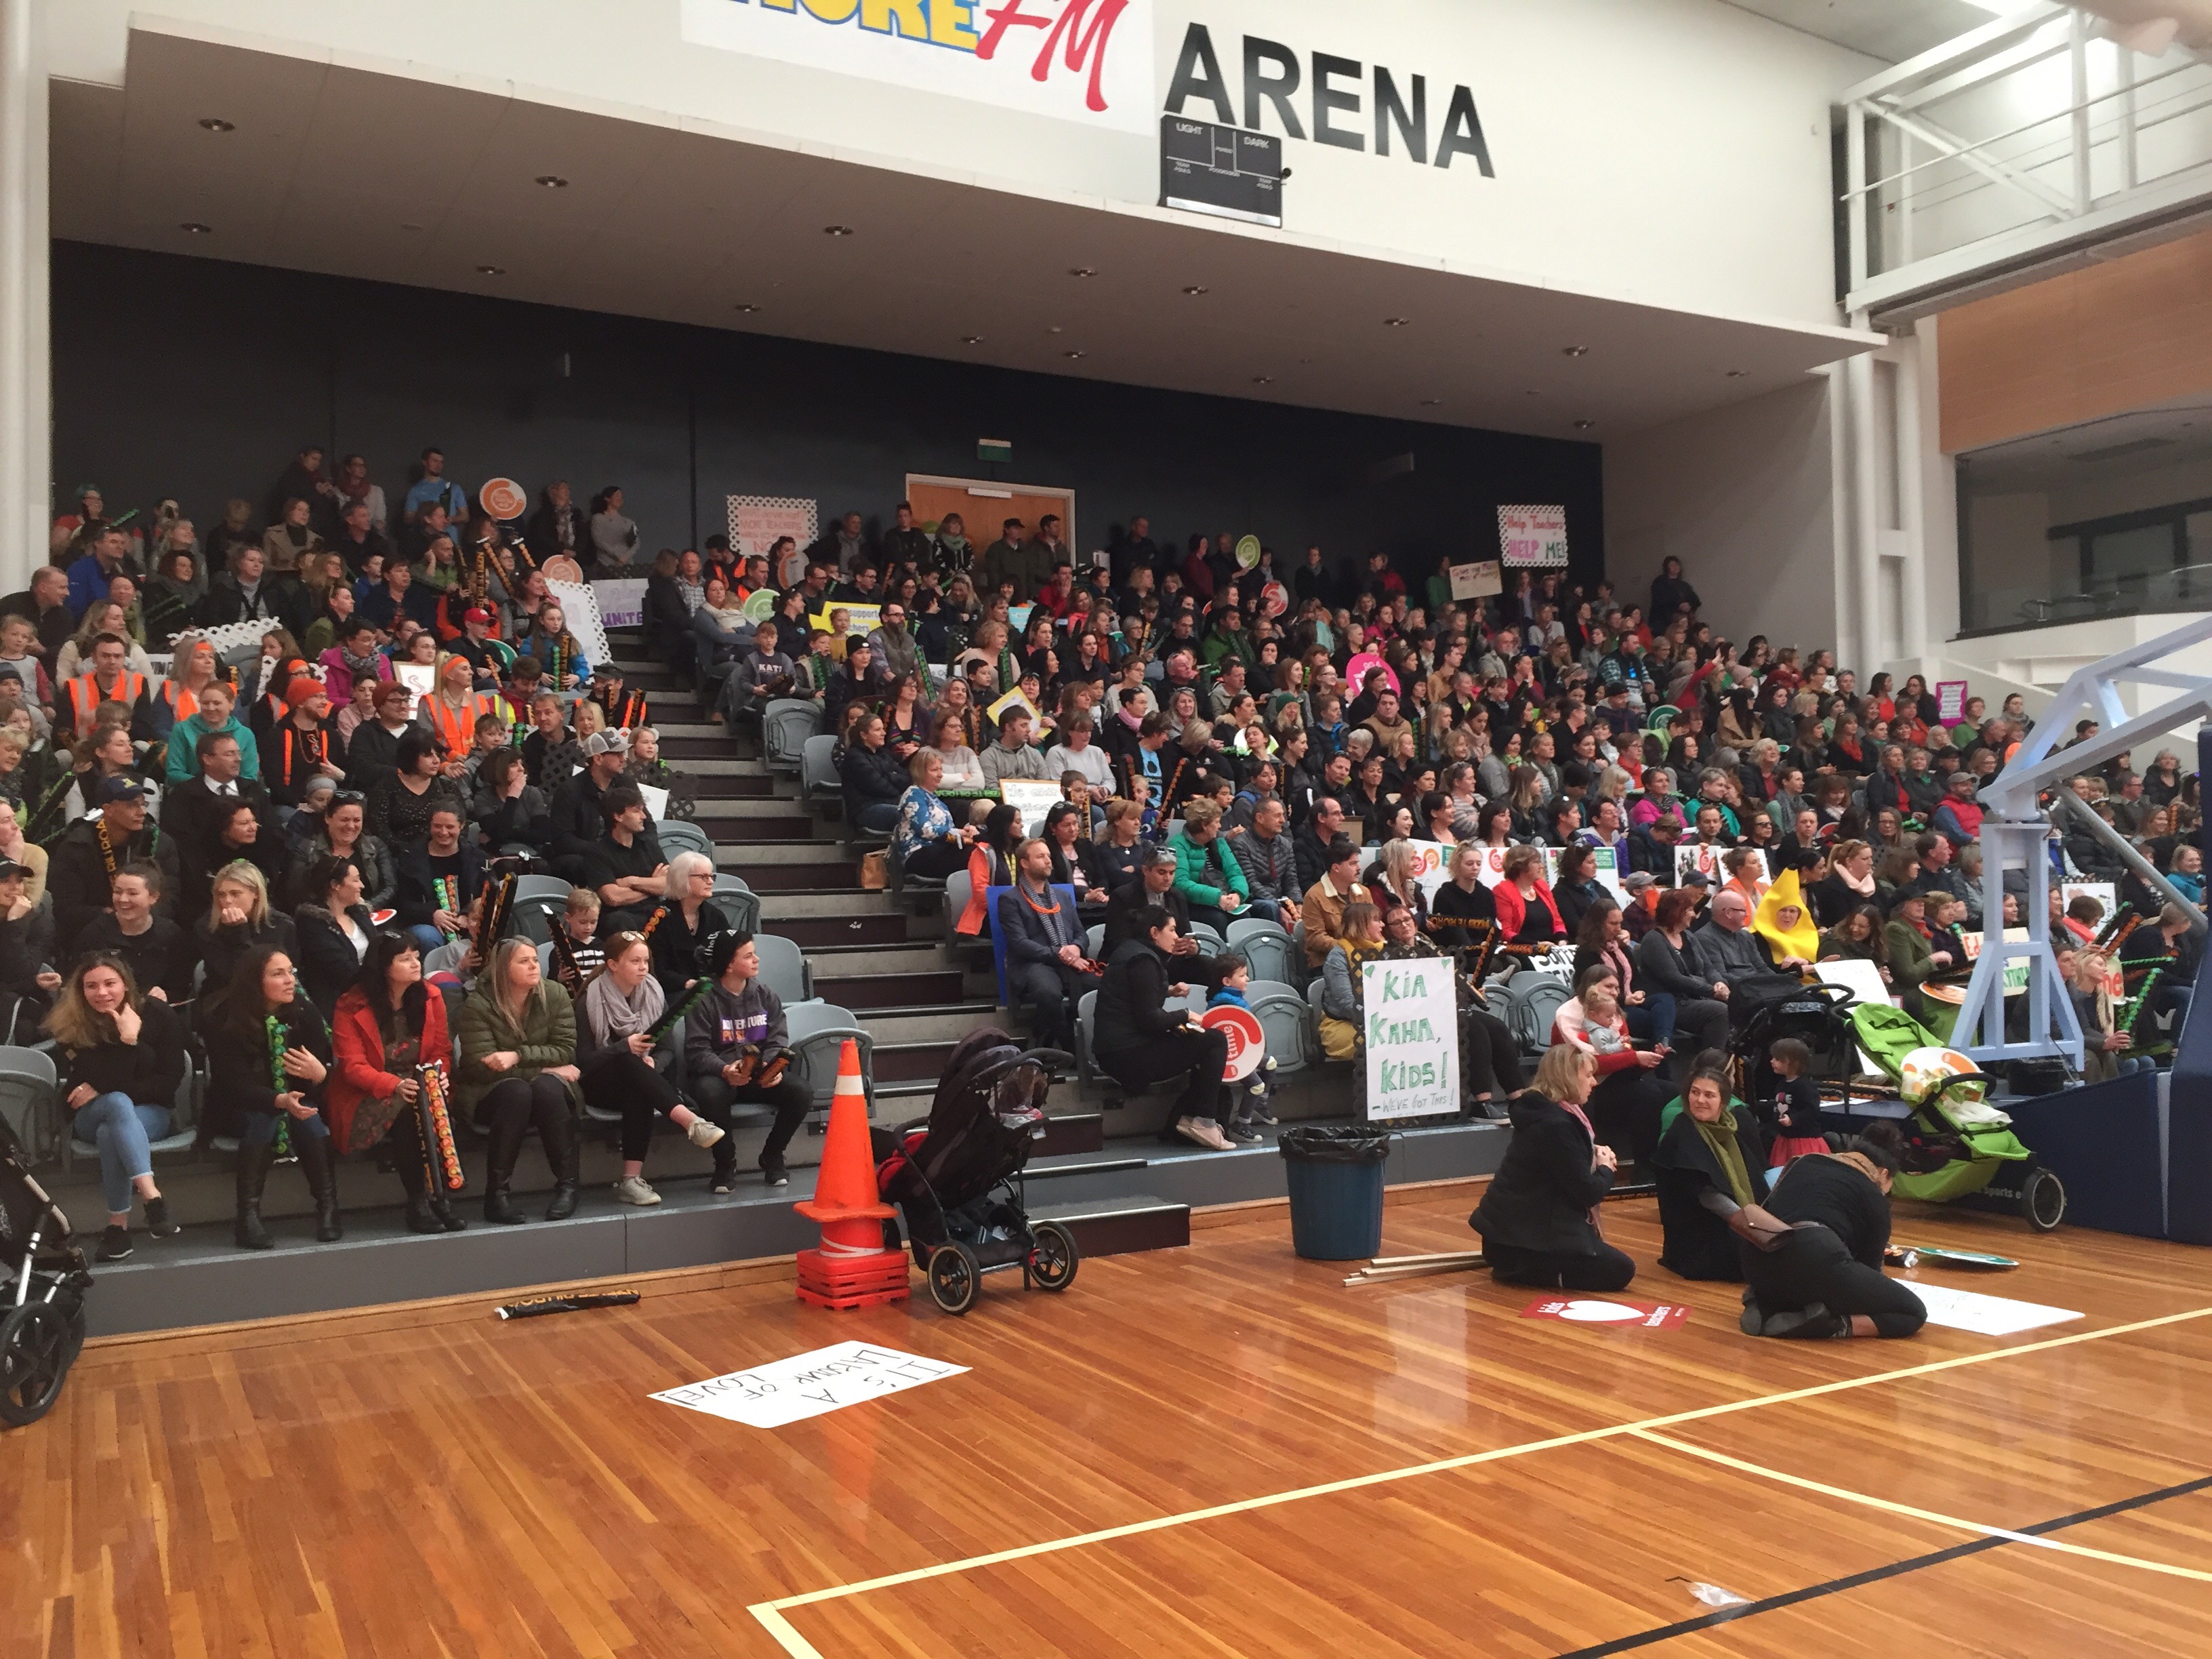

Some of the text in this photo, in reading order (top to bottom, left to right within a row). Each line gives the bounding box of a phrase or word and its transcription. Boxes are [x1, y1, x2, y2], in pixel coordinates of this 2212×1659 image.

[1164, 22, 1496, 179] ARENA
[1176, 122, 1204, 136] LIGHT
[1243, 136, 1269, 149] DARK
[1507, 514, 1526, 535] Help
[1508, 539, 1540, 559] HELP
[1368, 1012, 1441, 1048] KAHA,
[1536, 1301, 1566, 1315] kids
[1641, 1305, 1672, 1327] teachers
[657, 1374, 768, 1407] LOVE!
[742, 1382, 781, 1401] OF
[800, 1387, 840, 1404] A
